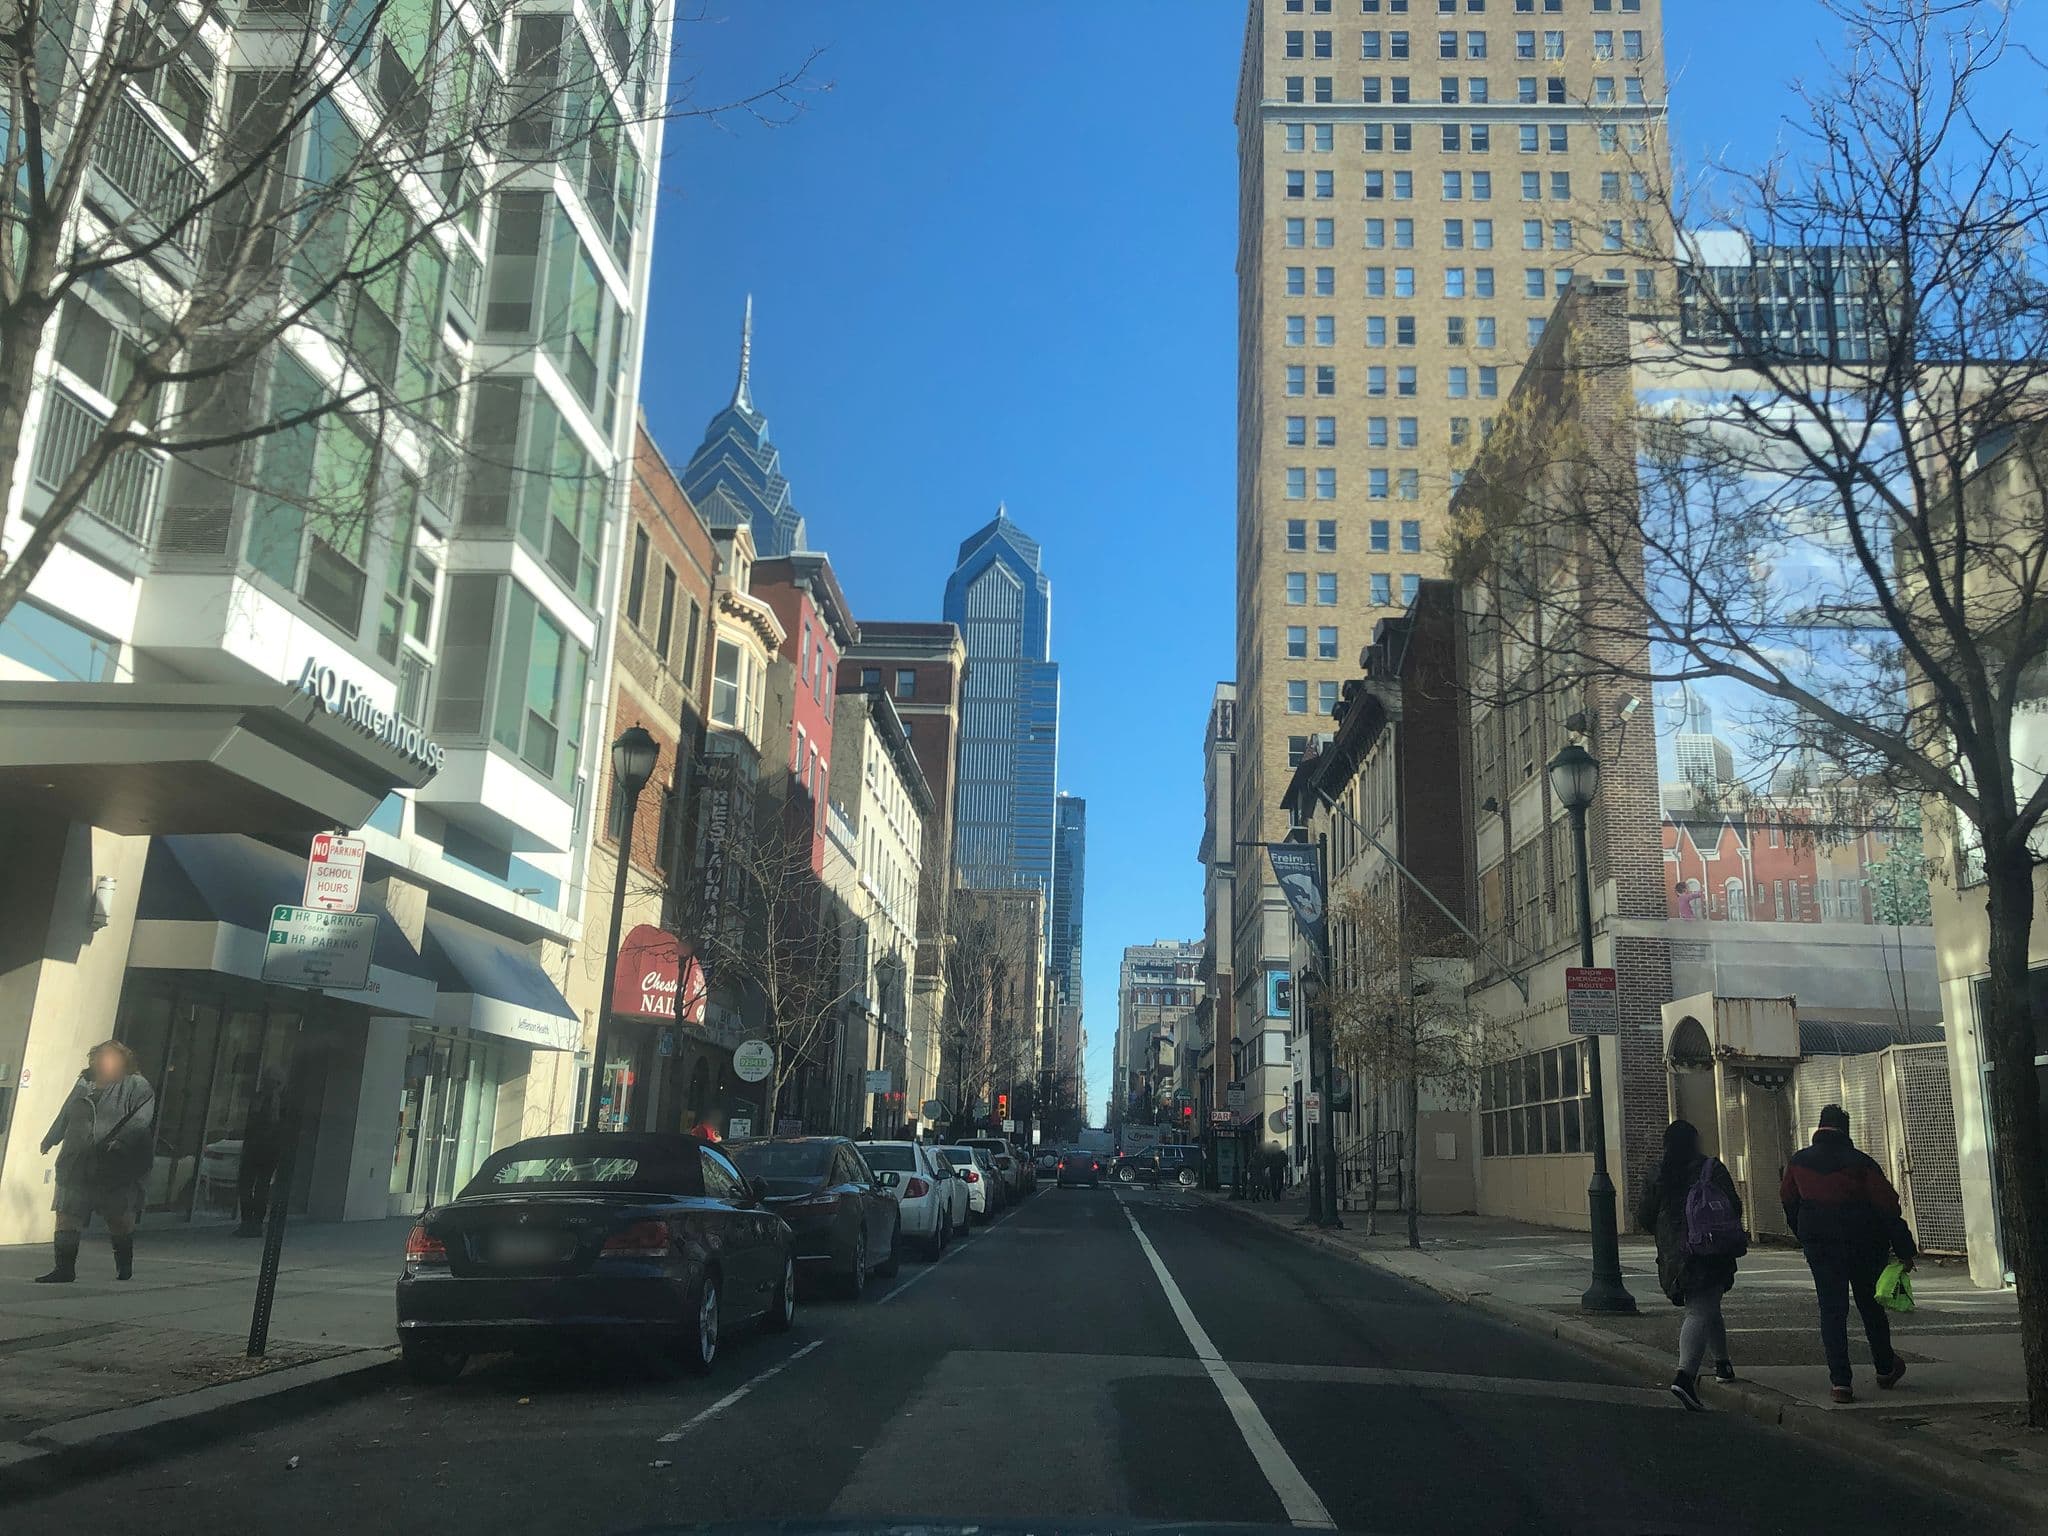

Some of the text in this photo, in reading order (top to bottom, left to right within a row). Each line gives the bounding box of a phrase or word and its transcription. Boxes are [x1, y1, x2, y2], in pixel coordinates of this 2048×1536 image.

[299, 658, 447, 771] AQ Rittenhouse
[314, 841, 362, 858] NO PARKING
[317, 866, 353, 880] SCHOOL
[317, 881, 349, 894] HOURS
[279, 910, 364, 928] 2 HR PARKING
[275, 932, 359, 950] 3 HR PARKING
[640, 994, 685, 1016] NAIL
[1211, 1112, 1232, 1121] PAR
